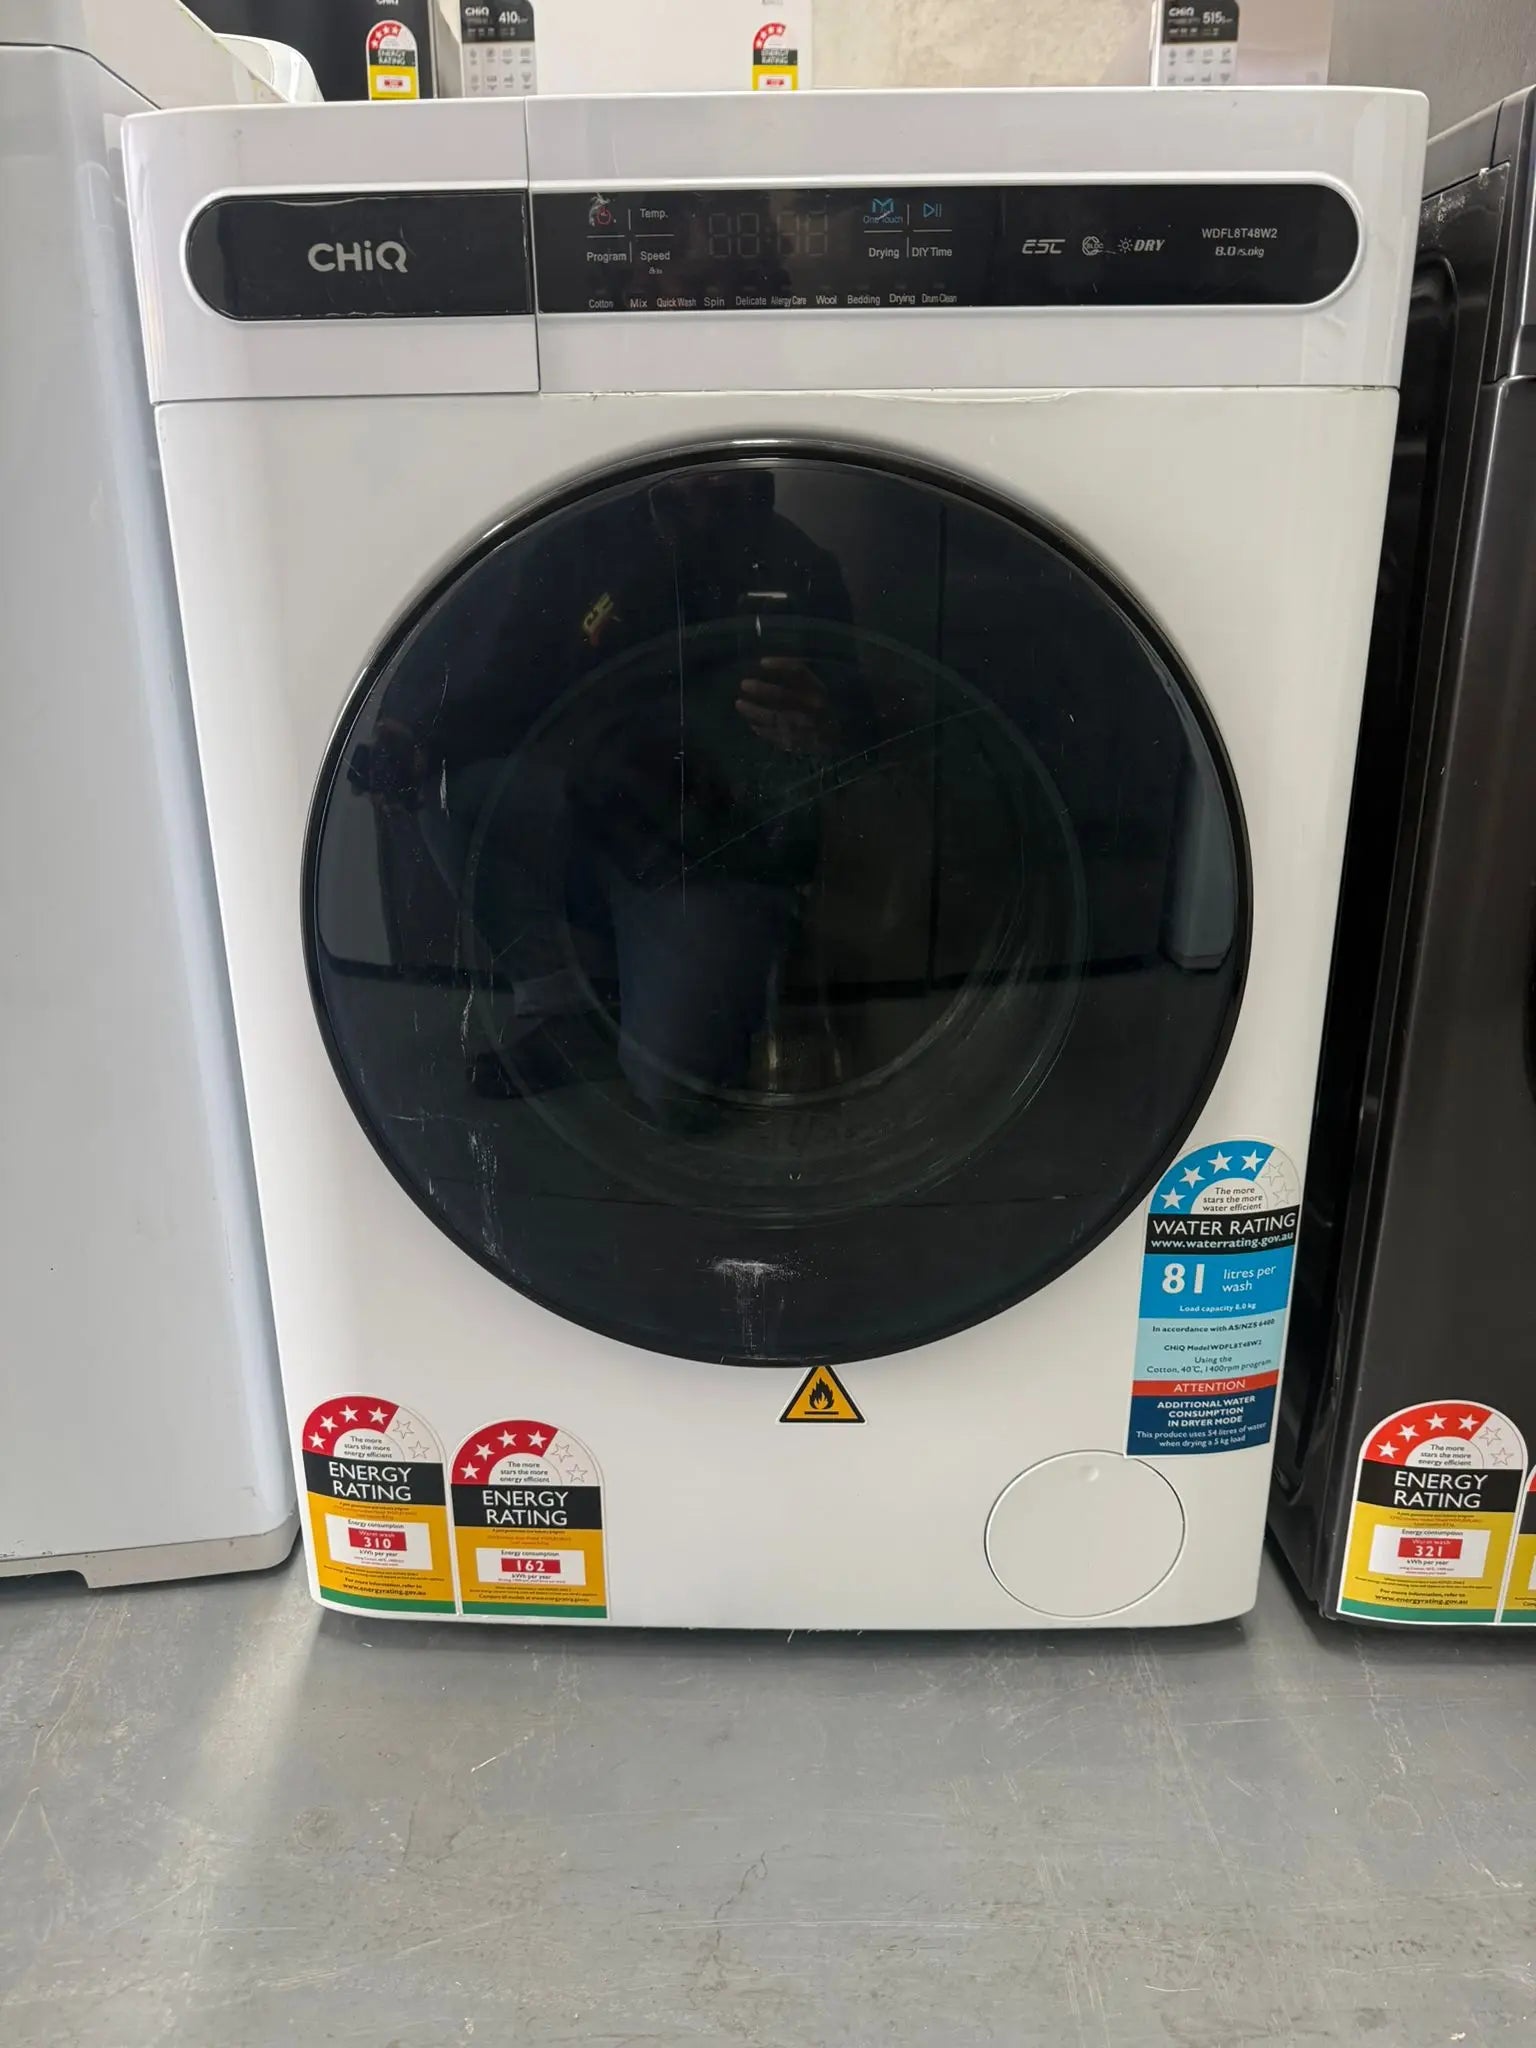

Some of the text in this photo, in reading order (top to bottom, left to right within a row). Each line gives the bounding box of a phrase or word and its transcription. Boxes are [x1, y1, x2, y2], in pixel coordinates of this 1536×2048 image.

[640, 208, 669, 219] Temp.
[1201, 228, 1278, 239] WDFL8T48W2
[1133, 239, 1165, 251] DRY
[308, 240, 408, 273] CHiQ
[586, 251, 627, 263] Program
[640, 251, 671, 262] Speed
[868, 247, 900, 259] Drying
[912, 247, 953, 257] DIY Time
[588, 299, 614, 309] Cotton
[630, 298, 648, 308] Mix
[656, 297, 697, 308] Quick Wash
[703, 297, 725, 308] Spin
[735, 295, 767, 306] Delicate
[816, 295, 837, 305] Wool
[847, 294, 881, 306] Bedding
[889, 293, 916, 305] Drying
[1215, 1187, 1230, 1195] The
[1226, 1195, 1240, 1203] the
[1241, 1194, 1263, 1202] more
[1229, 1203, 1262, 1211] efficient
[1153, 1212, 1296, 1236] WATER RATING
[1151, 1232, 1294, 1248] www.waterrating.gov.au
[1162, 1263, 1277, 1294] 81 litres per
[1222, 1281, 1253, 1292] wash
[1201, 1304, 1234, 1312] capacity
[1248, 1302, 1257, 1310] kg
[1258, 1318, 1275, 1327] 6400
[1163, 1344, 1186, 1352] CHiQ
[1194, 1356, 1218, 1364] Using
[1146, 1366, 1179, 1374] Cotton,
[1205, 1364, 1240, 1373] 1400rpm
[1241, 1359, 1272, 1371] program
[1174, 1379, 1246, 1393] ATTENTION
[1157, 1395, 1256, 1409] ADDITIONAL WATER
[1168, 1406, 1244, 1418] CONSUMPTION
[1167, 1415, 1243, 1427] IN DRYER MODE
[1154, 1431, 1187, 1440] produce
[1207, 1429, 1218, 1437] 54
[1218, 1428, 1237, 1436] litres
[1238, 1425, 1247, 1433] of
[1247, 1422, 1267, 1432] water
[350, 1435, 363, 1443] The
[1182, 1439, 1208, 1448] drying
[1220, 1437, 1229, 1445] kg
[1230, 1435, 1246, 1443] load
[1444, 1459, 1472, 1467] efficient
[328, 1461, 412, 1483] ENERGY
[1394, 1470, 1489, 1490] ENERGY
[332, 1480, 412, 1501] RATING
[482, 1490, 569, 1507] ENERGY
[1393, 1490, 1481, 1508] RATING
[486, 1508, 568, 1526] RATING
[348, 1519, 367, 1528] Energy
[363, 1537, 392, 1549] 310
[374, 1550, 384, 1558] per
[1414, 1545, 1443, 1558] 321
[516, 1560, 545, 1572] 162
